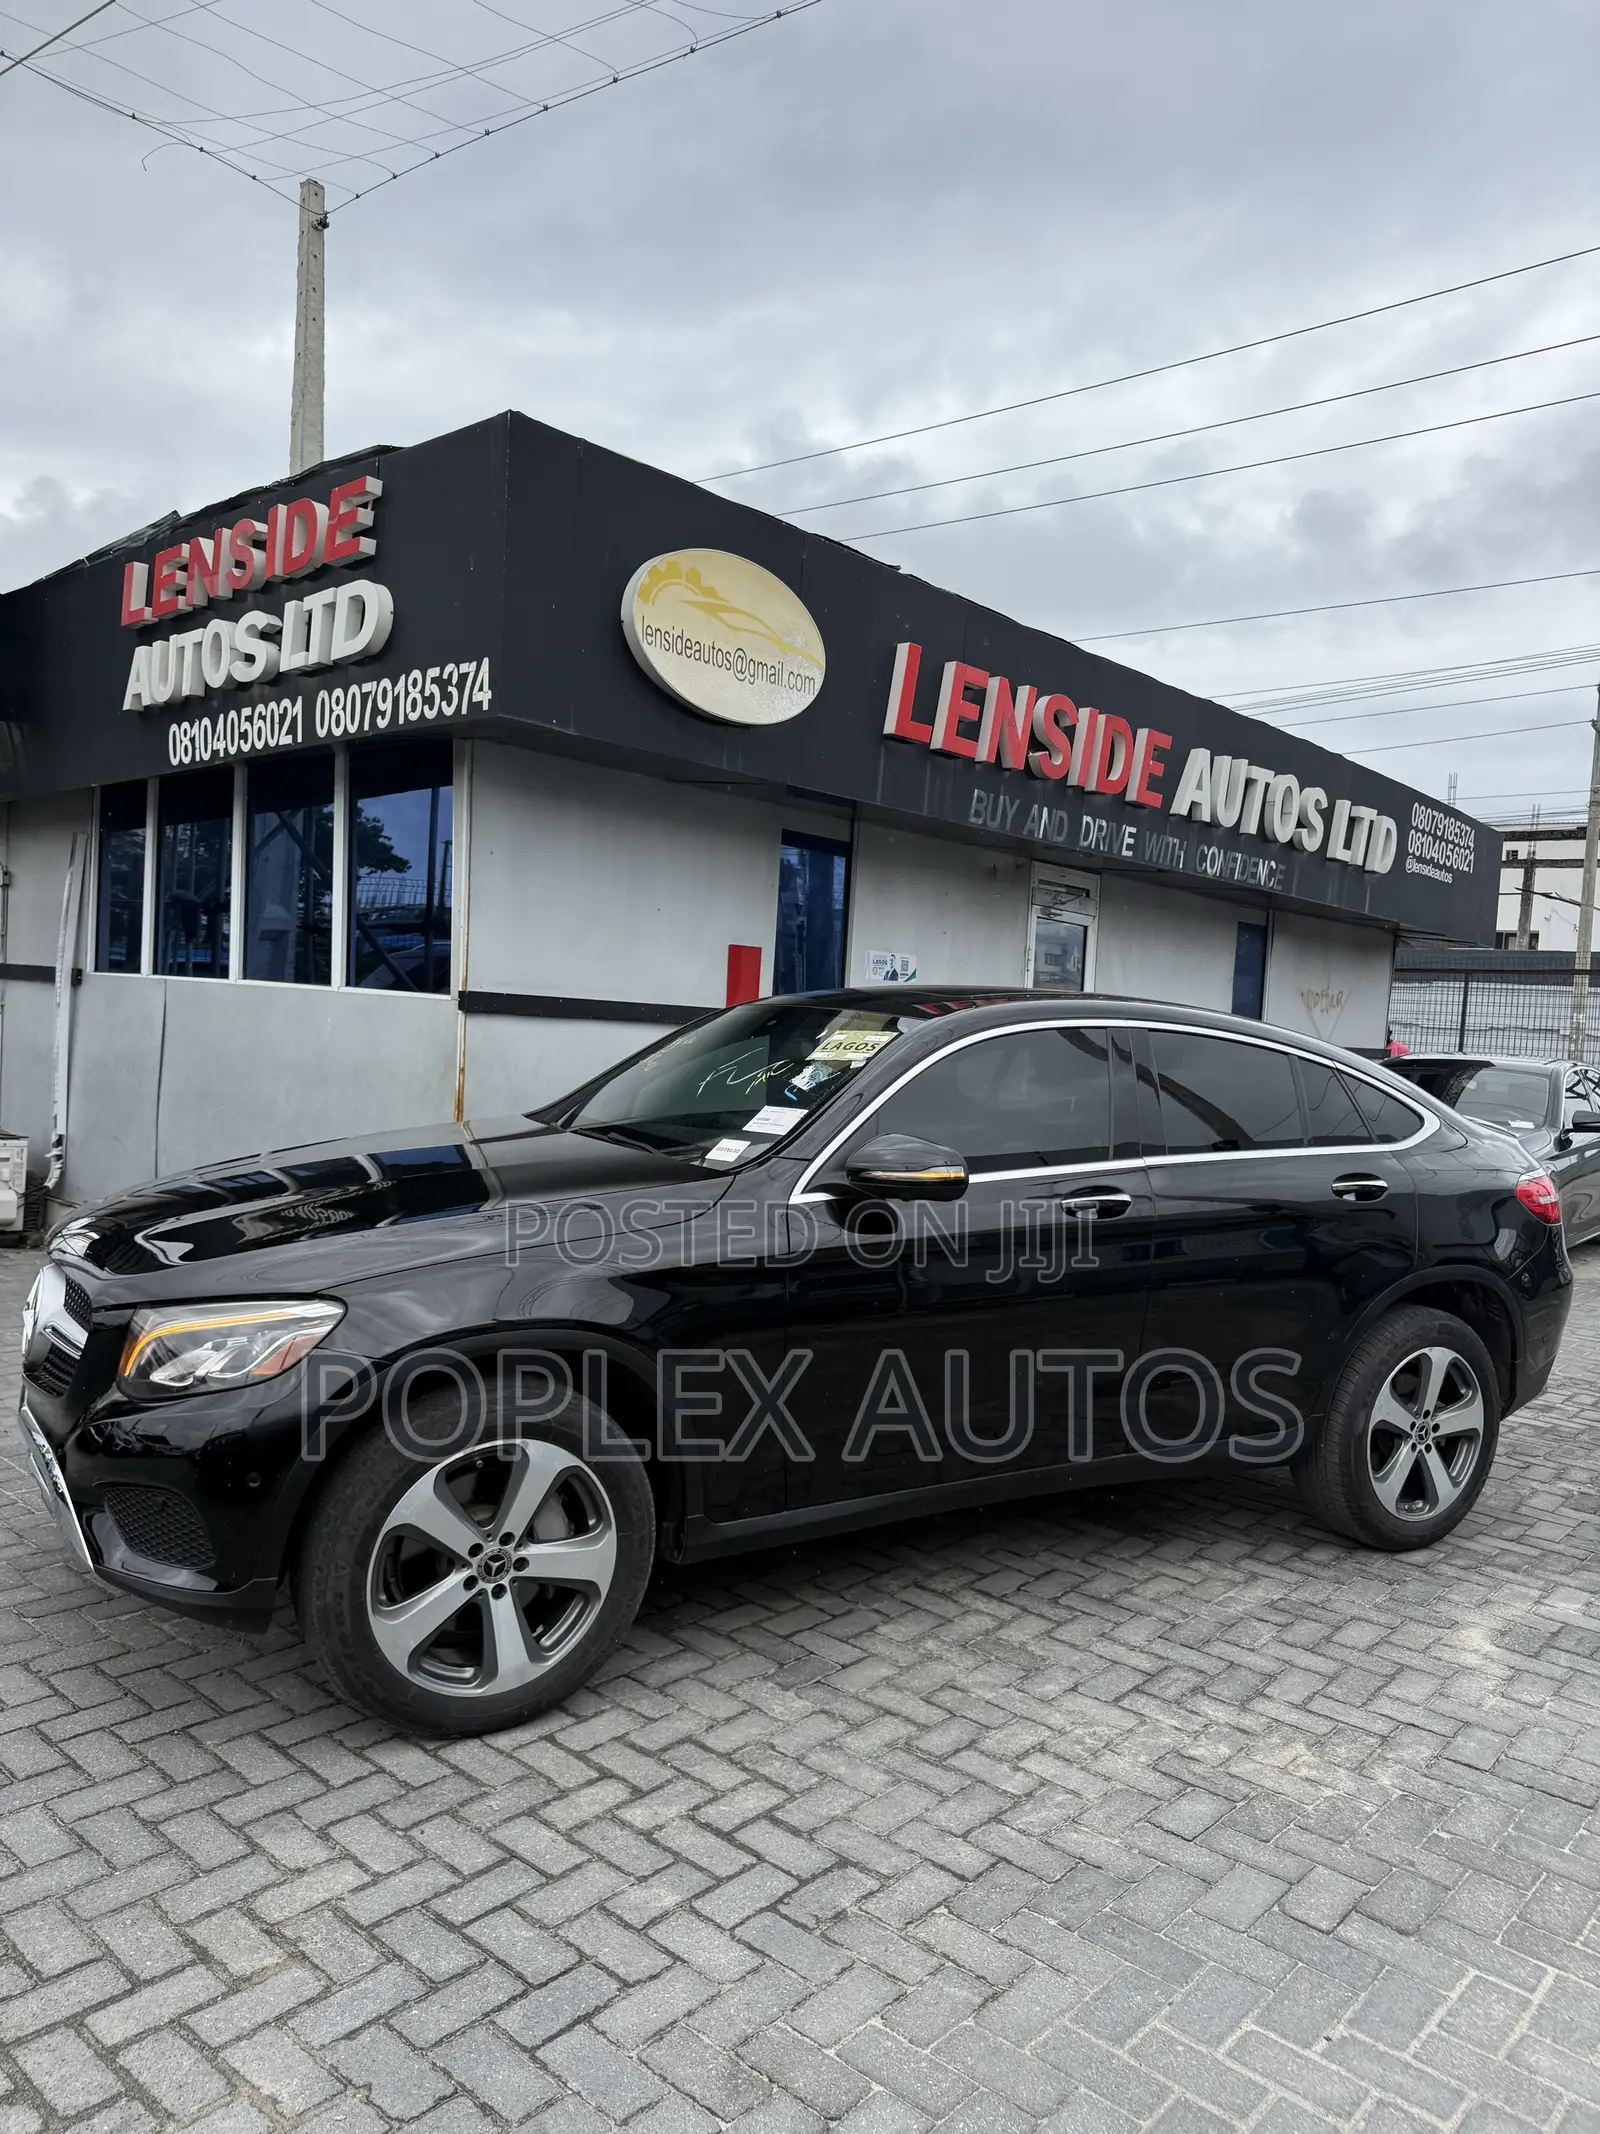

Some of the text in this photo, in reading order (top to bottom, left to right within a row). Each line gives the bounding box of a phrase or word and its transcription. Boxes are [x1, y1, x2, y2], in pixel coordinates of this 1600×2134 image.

[120, 475, 383, 627] LENSIDE
[122, 579, 394, 711] AUTOS LTD
[641, 615, 816, 696] lensideautos@gmail.com
[168, 656, 492, 767] 08104056021 08079185374
[883, 641, 1397, 875] LENSIDE AUTOS LTD
[968, 788, 1287, 891] BUY AND DRIVE WITH CONFIDENCE
[1405, 855, 1453, 884] @lensideautos
[1408, 829, 1475, 874] 08104056021
[1411, 802, 1475, 851] 08079185374
[821, 1041, 880, 1052] LAGOS
